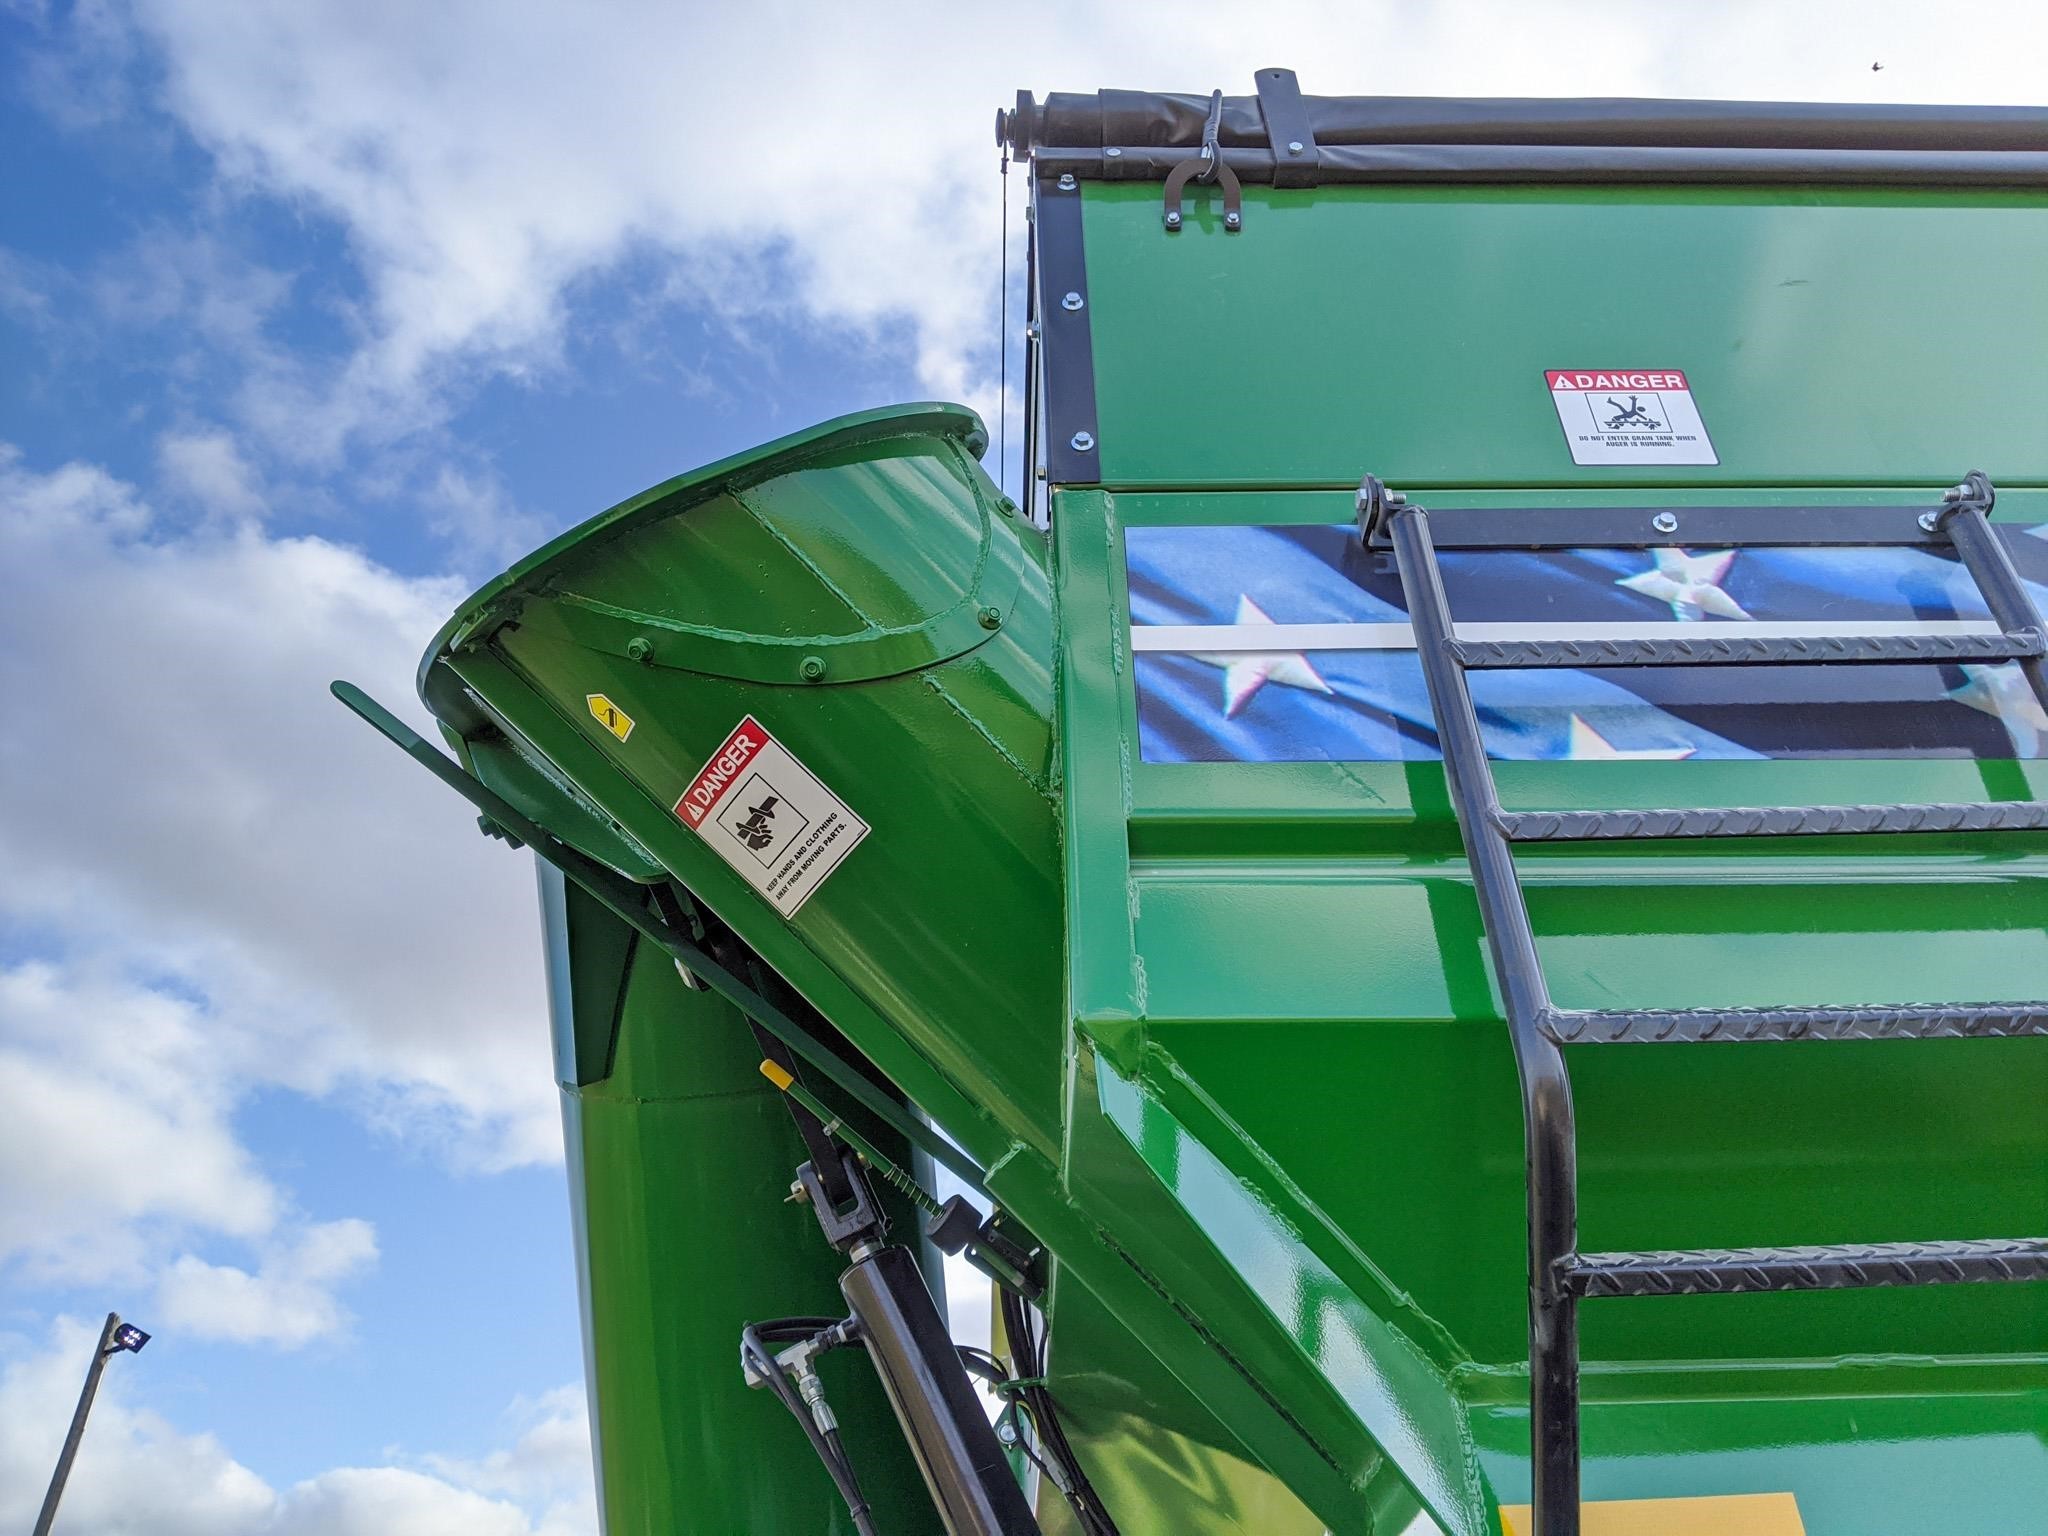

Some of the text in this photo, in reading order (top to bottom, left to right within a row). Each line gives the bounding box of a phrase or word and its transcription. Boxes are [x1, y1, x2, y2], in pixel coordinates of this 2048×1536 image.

[1575, 374, 1684, 389] DANGER
[693, 734, 758, 806] DANGER
[766, 812, 838, 893] KEEP HANDS AND CLOTHING
[775, 823, 847, 901] AWAY FROM MOVING PARTS.
